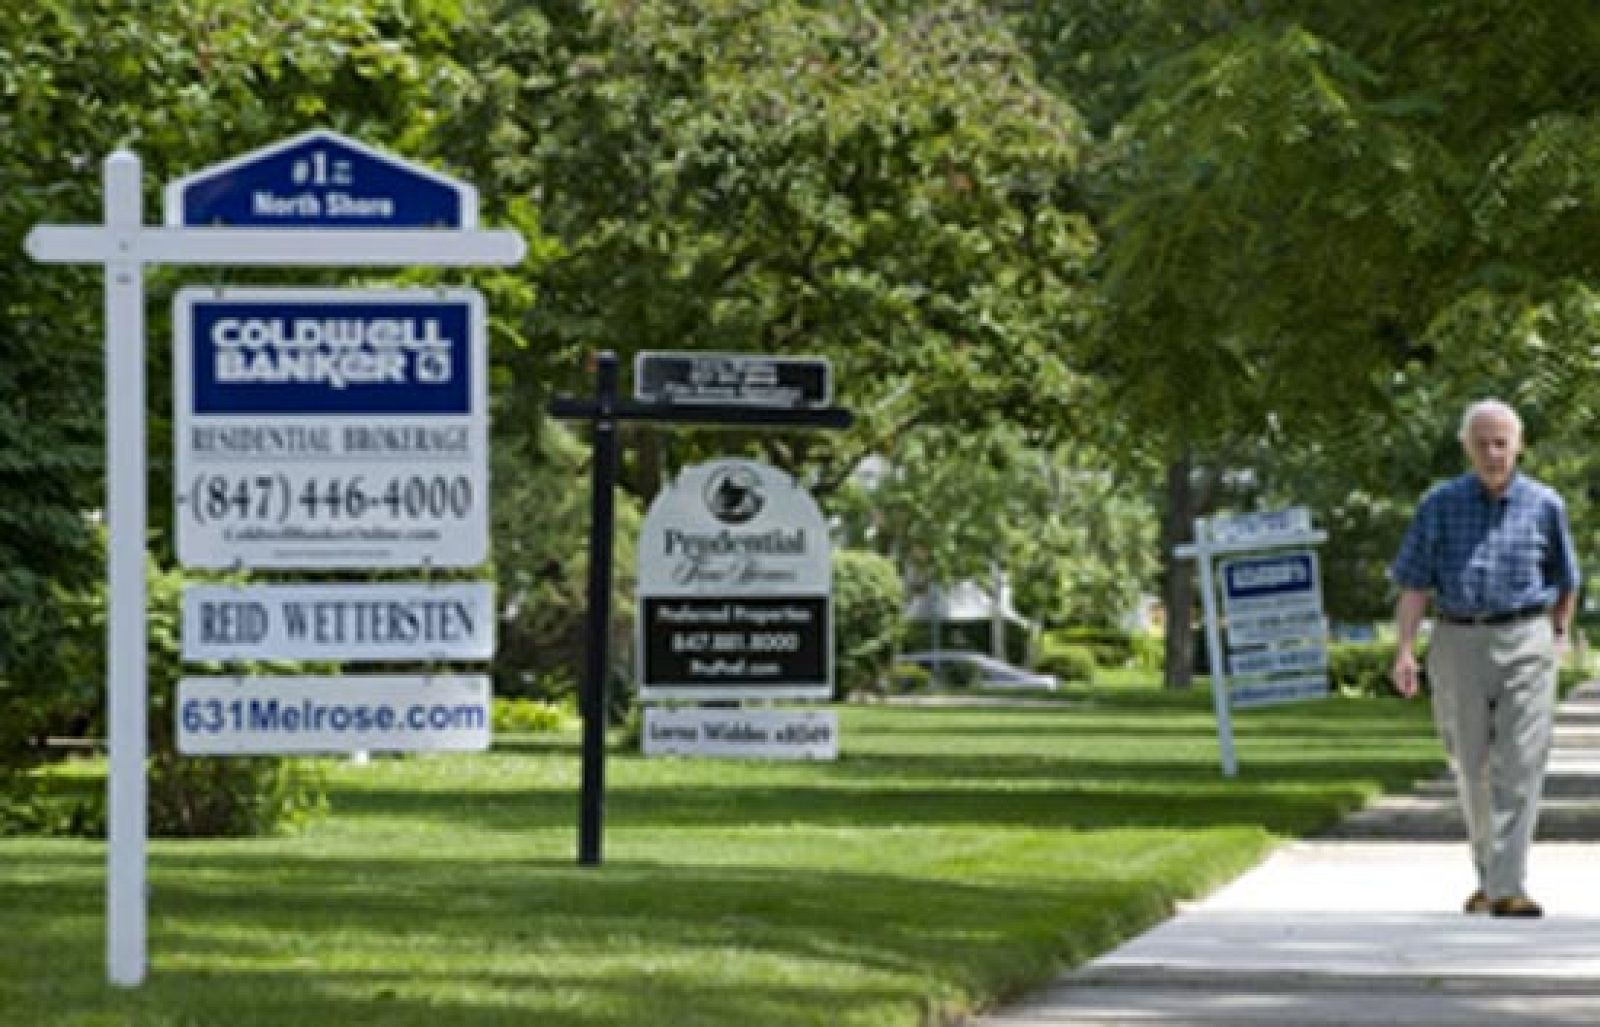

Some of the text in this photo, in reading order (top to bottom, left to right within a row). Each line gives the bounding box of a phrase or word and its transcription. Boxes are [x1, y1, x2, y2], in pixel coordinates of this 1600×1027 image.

[253, 191, 393, 217] North Shore
[211, 317, 453, 349] COLDWELL
[214, 349, 408, 389] BANKER
[190, 425, 471, 453] RESIDENTIAL BROKERAGE
[664, 527, 807, 559] Prudential
[200, 599, 476, 645] REID WETTERSTEN
[181, 698, 486, 734] 631Melrose.com
